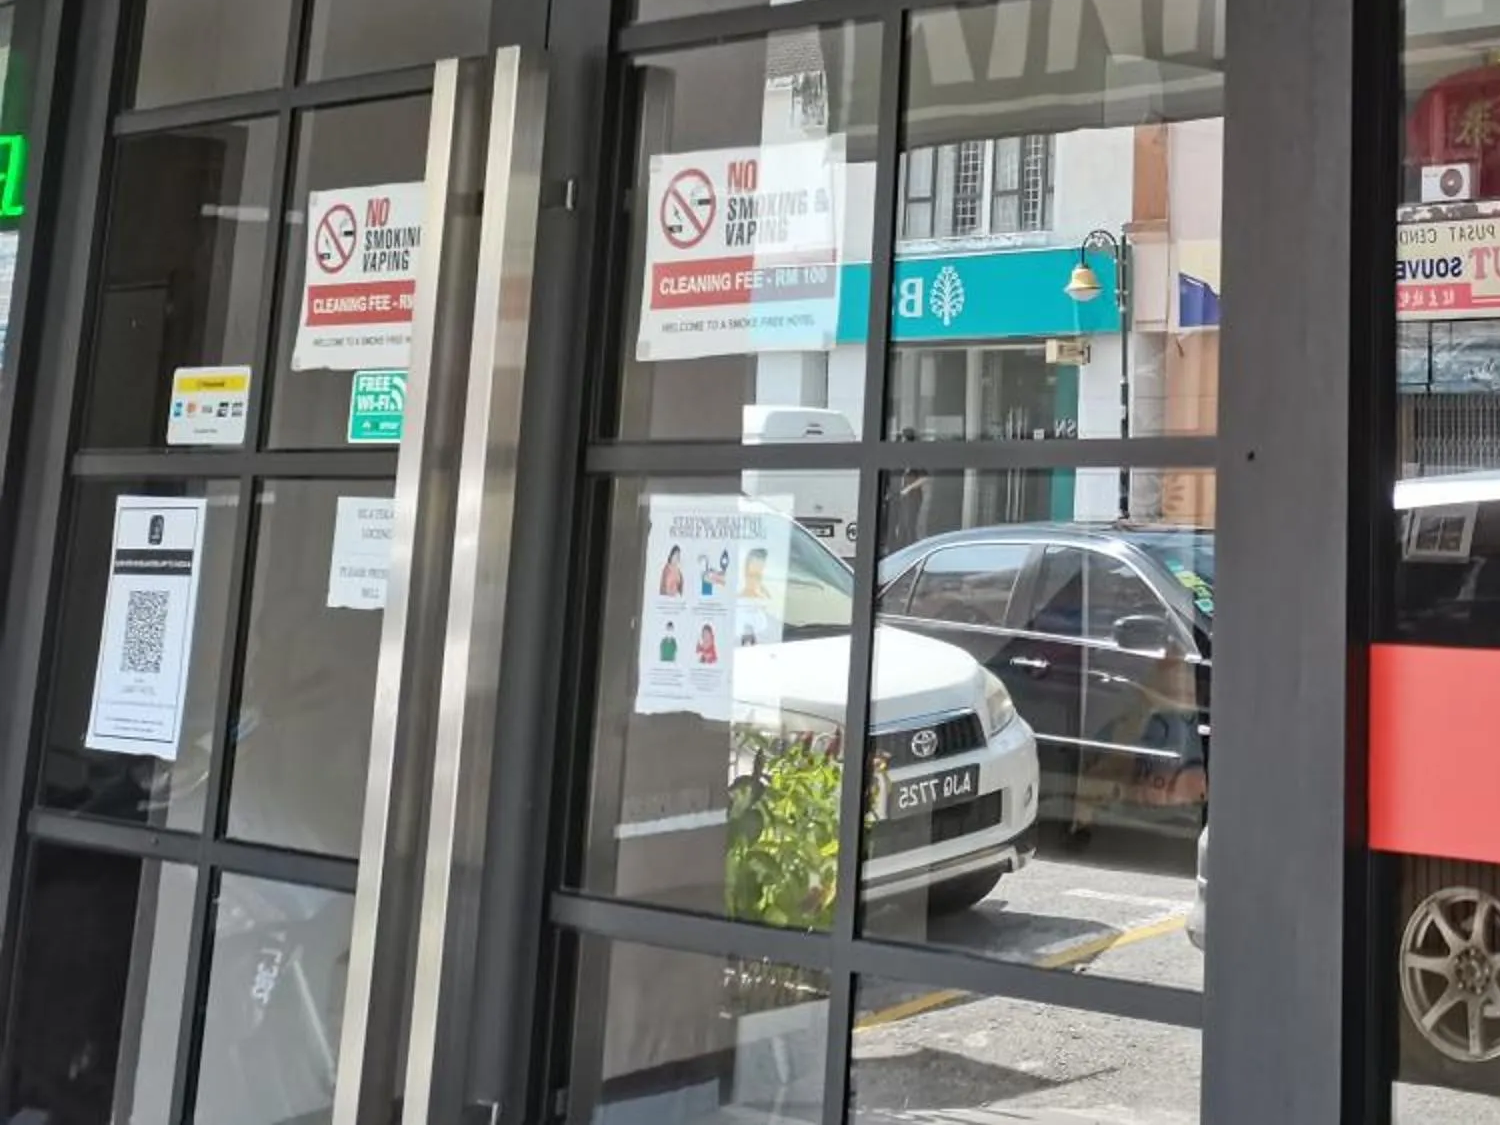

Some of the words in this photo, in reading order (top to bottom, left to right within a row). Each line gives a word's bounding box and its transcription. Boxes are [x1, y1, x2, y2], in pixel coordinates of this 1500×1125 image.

[728, 159, 758, 192] NO
[365, 197, 391, 227] NO
[727, 190, 809, 221] SMOKING
[725, 218, 789, 246] VAPING
[362, 250, 411, 274] VAPING
[659, 272, 731, 296] CLEANING
[735, 269, 764, 291] FEE
[775, 268, 799, 289] RM
[313, 295, 367, 316] CLEANING
[368, 294, 392, 312] FEE
[662, 321, 704, 333] WELCOME
[707, 320, 719, 331] TO
[729, 318, 758, 329] SMOKE
[359, 376, 390, 392] FREE
